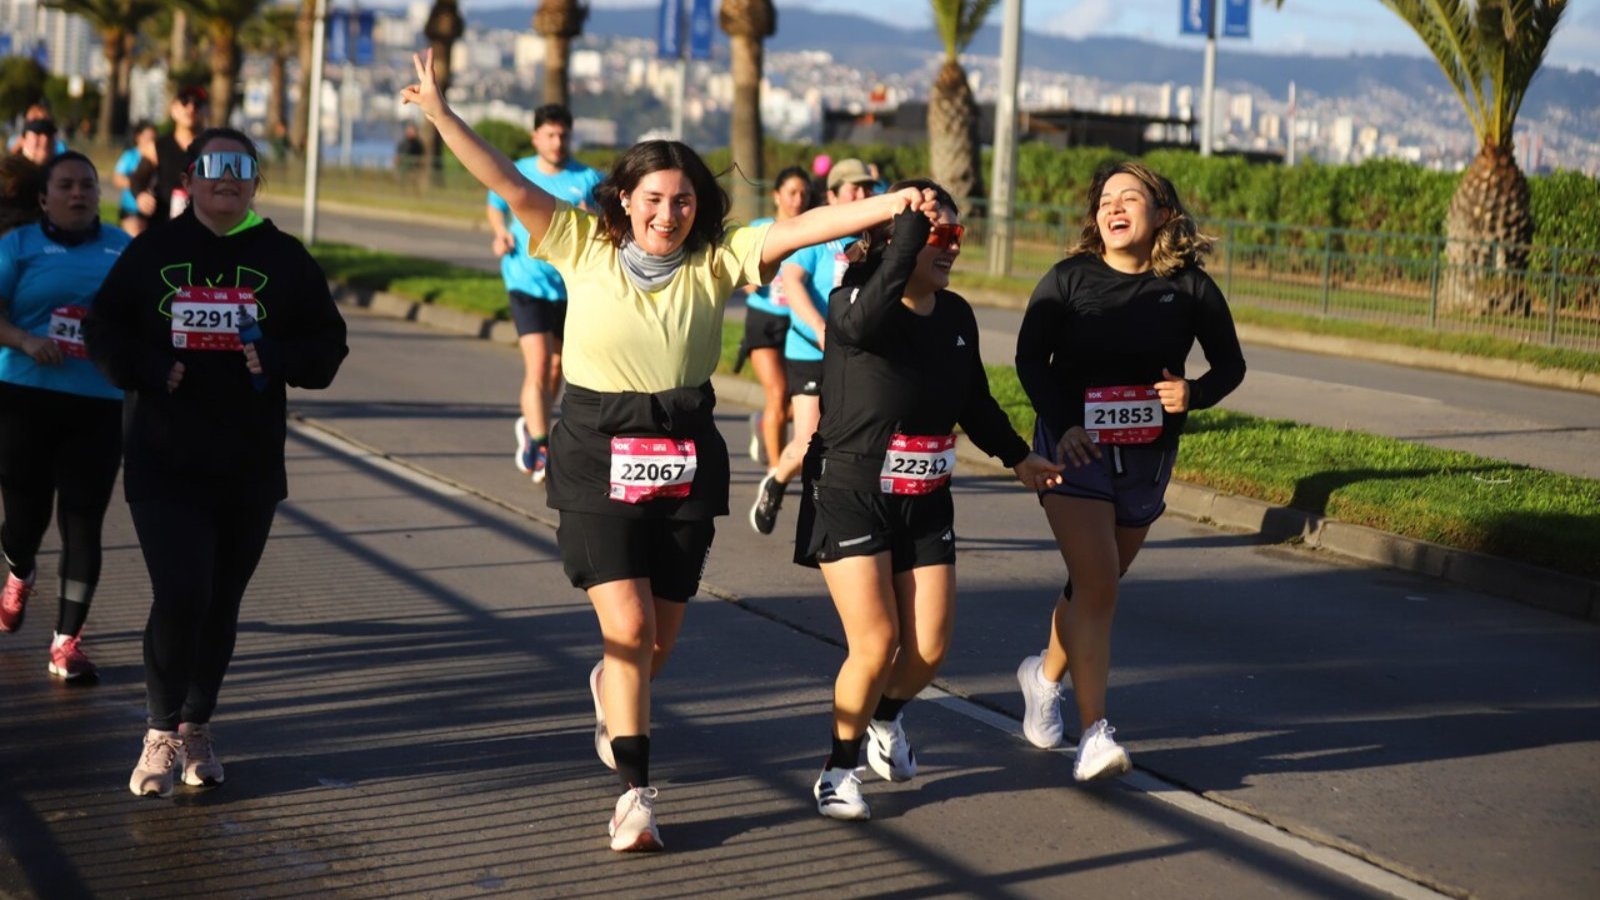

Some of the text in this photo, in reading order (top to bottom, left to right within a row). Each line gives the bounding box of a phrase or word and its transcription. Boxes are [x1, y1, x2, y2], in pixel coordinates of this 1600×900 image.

[1094, 407, 1153, 424] 21853
[613, 443, 630, 451] 10K
[892, 439, 906, 448] 10K
[621, 464, 686, 480] 22067
[891, 458, 947, 475] 22342
